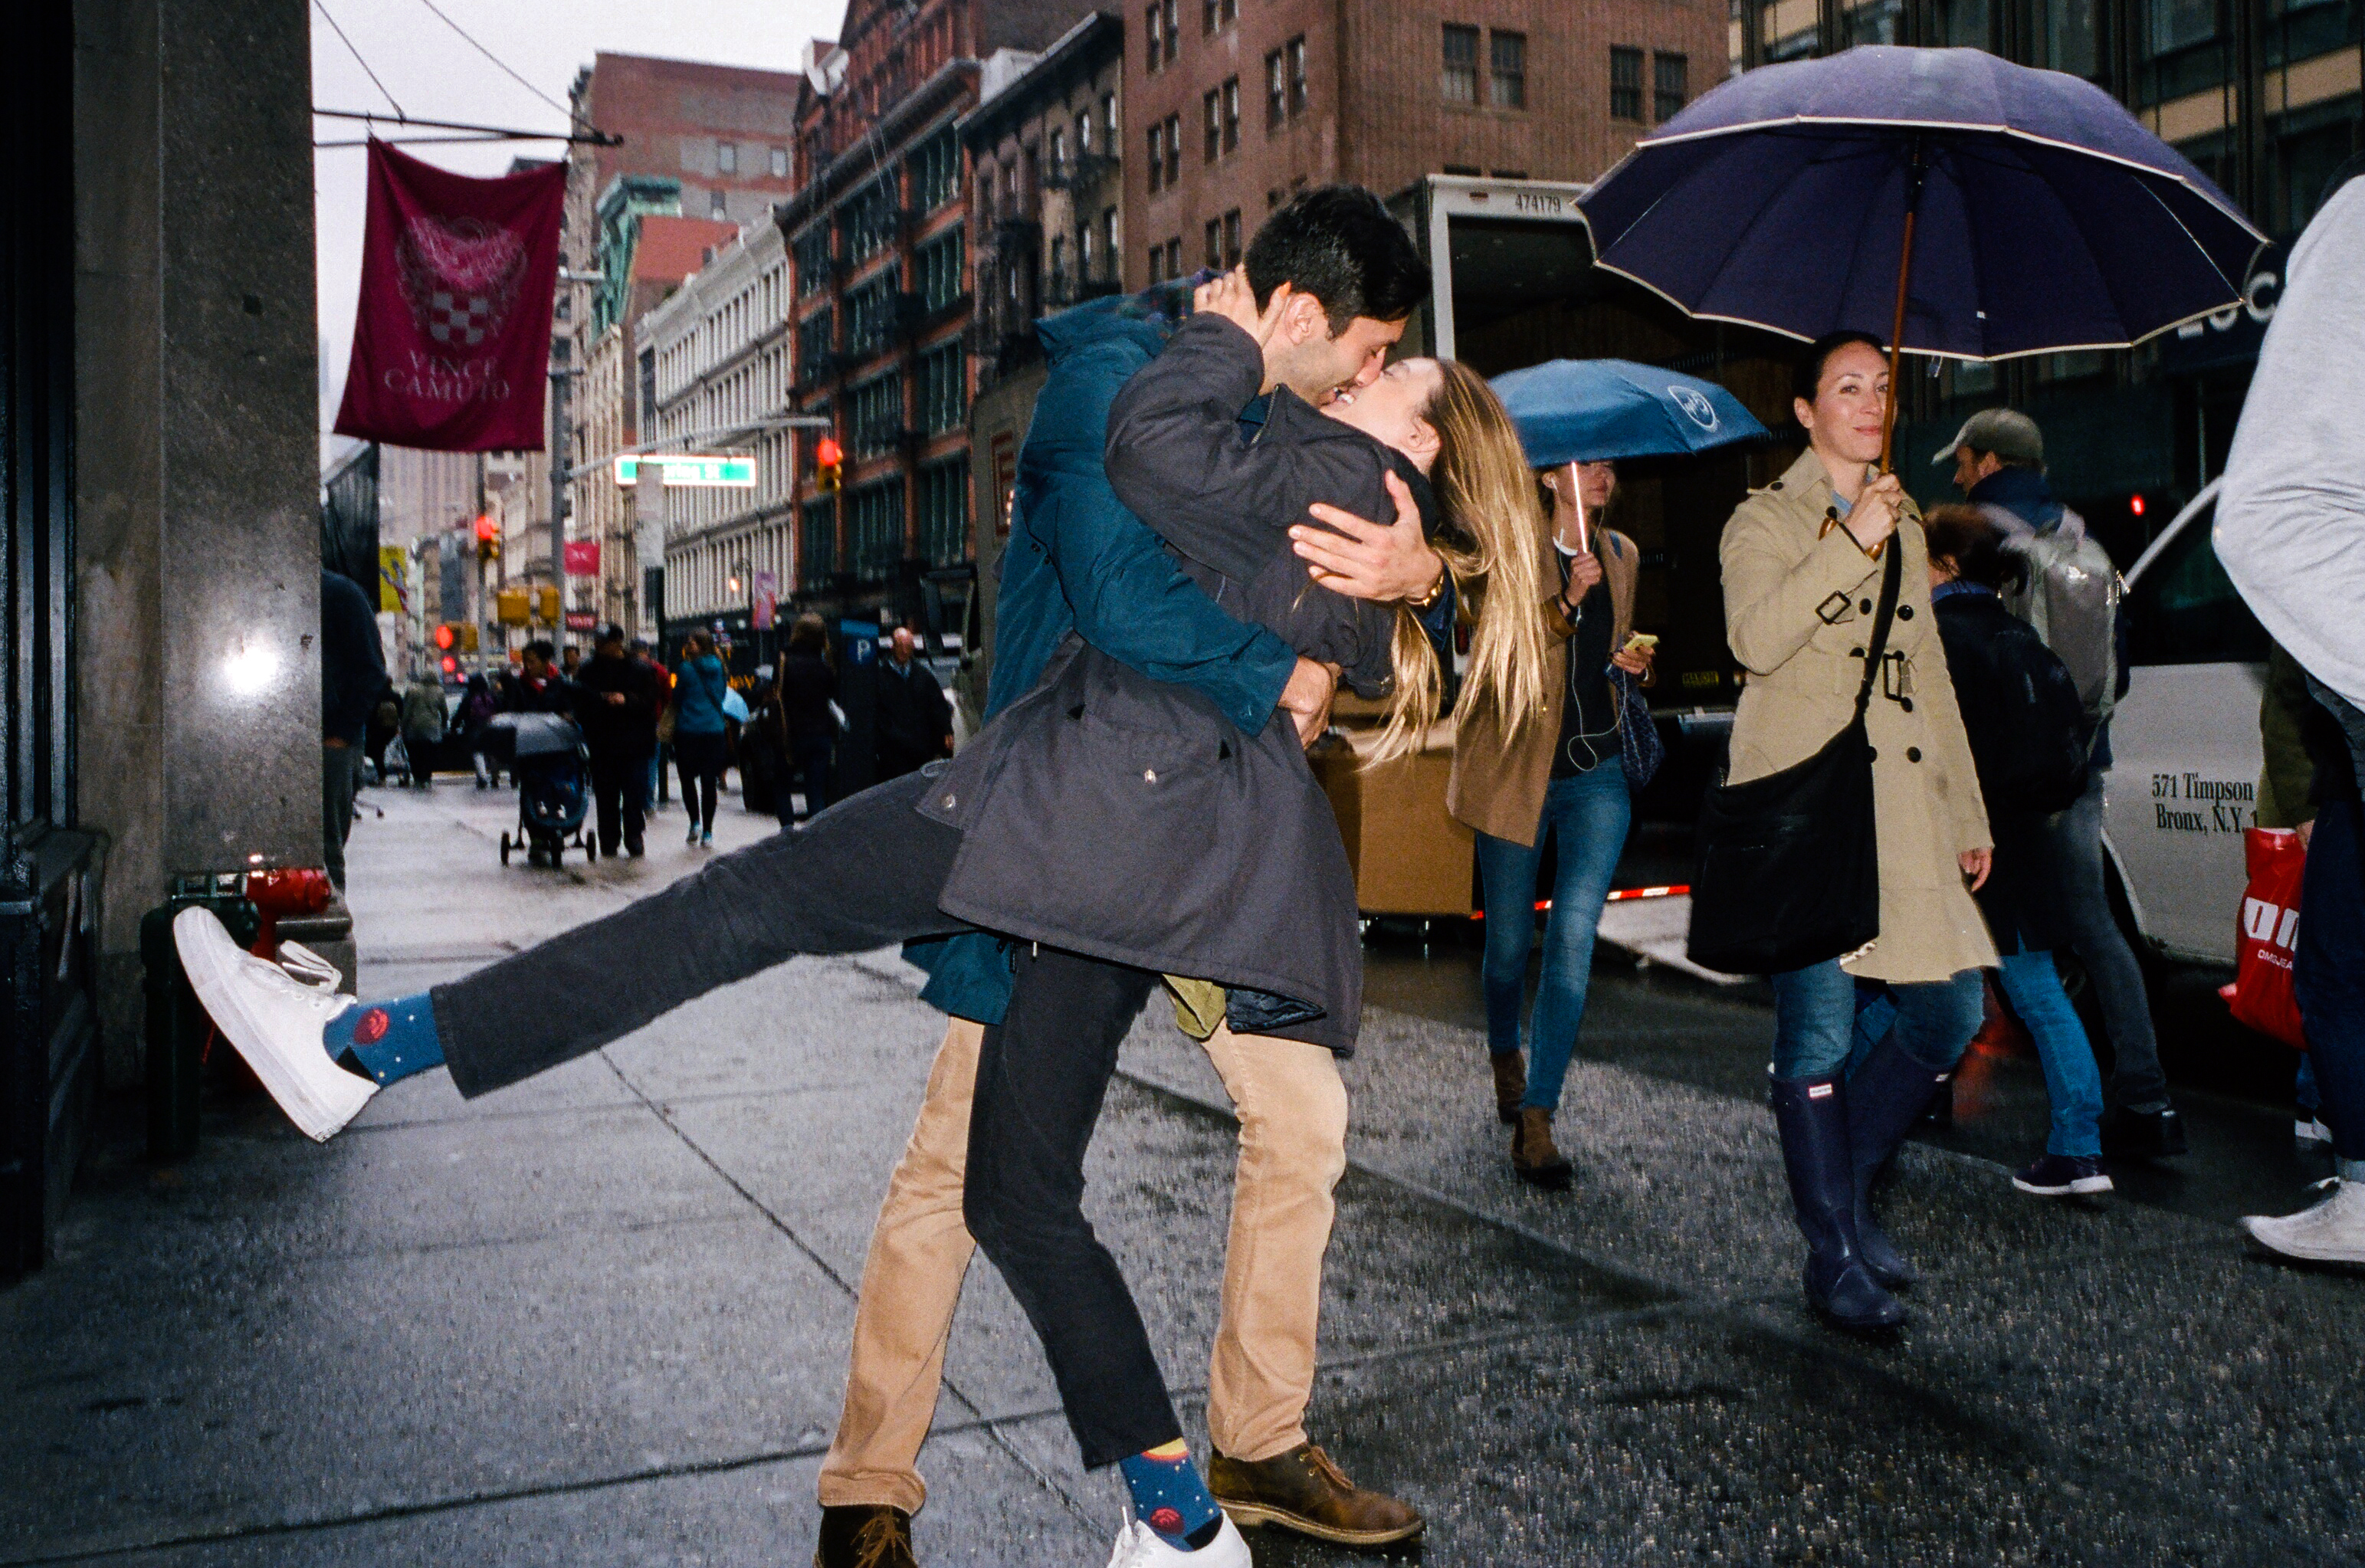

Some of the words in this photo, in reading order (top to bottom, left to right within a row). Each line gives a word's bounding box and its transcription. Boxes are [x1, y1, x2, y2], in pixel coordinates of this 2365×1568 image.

[1515, 194, 1560, 212] 474179
[410, 349, 497, 380] VINCE
[385, 368, 510, 402] CAMUTO
[705, 464, 720, 479] St
[857, 638, 871, 662] P
[2152, 773, 2176, 798] 571
[2183, 772, 2254, 807] Timpson
[2155, 803, 2207, 835] Bronx,
[2258, 950, 2294, 970] OMGJEA
